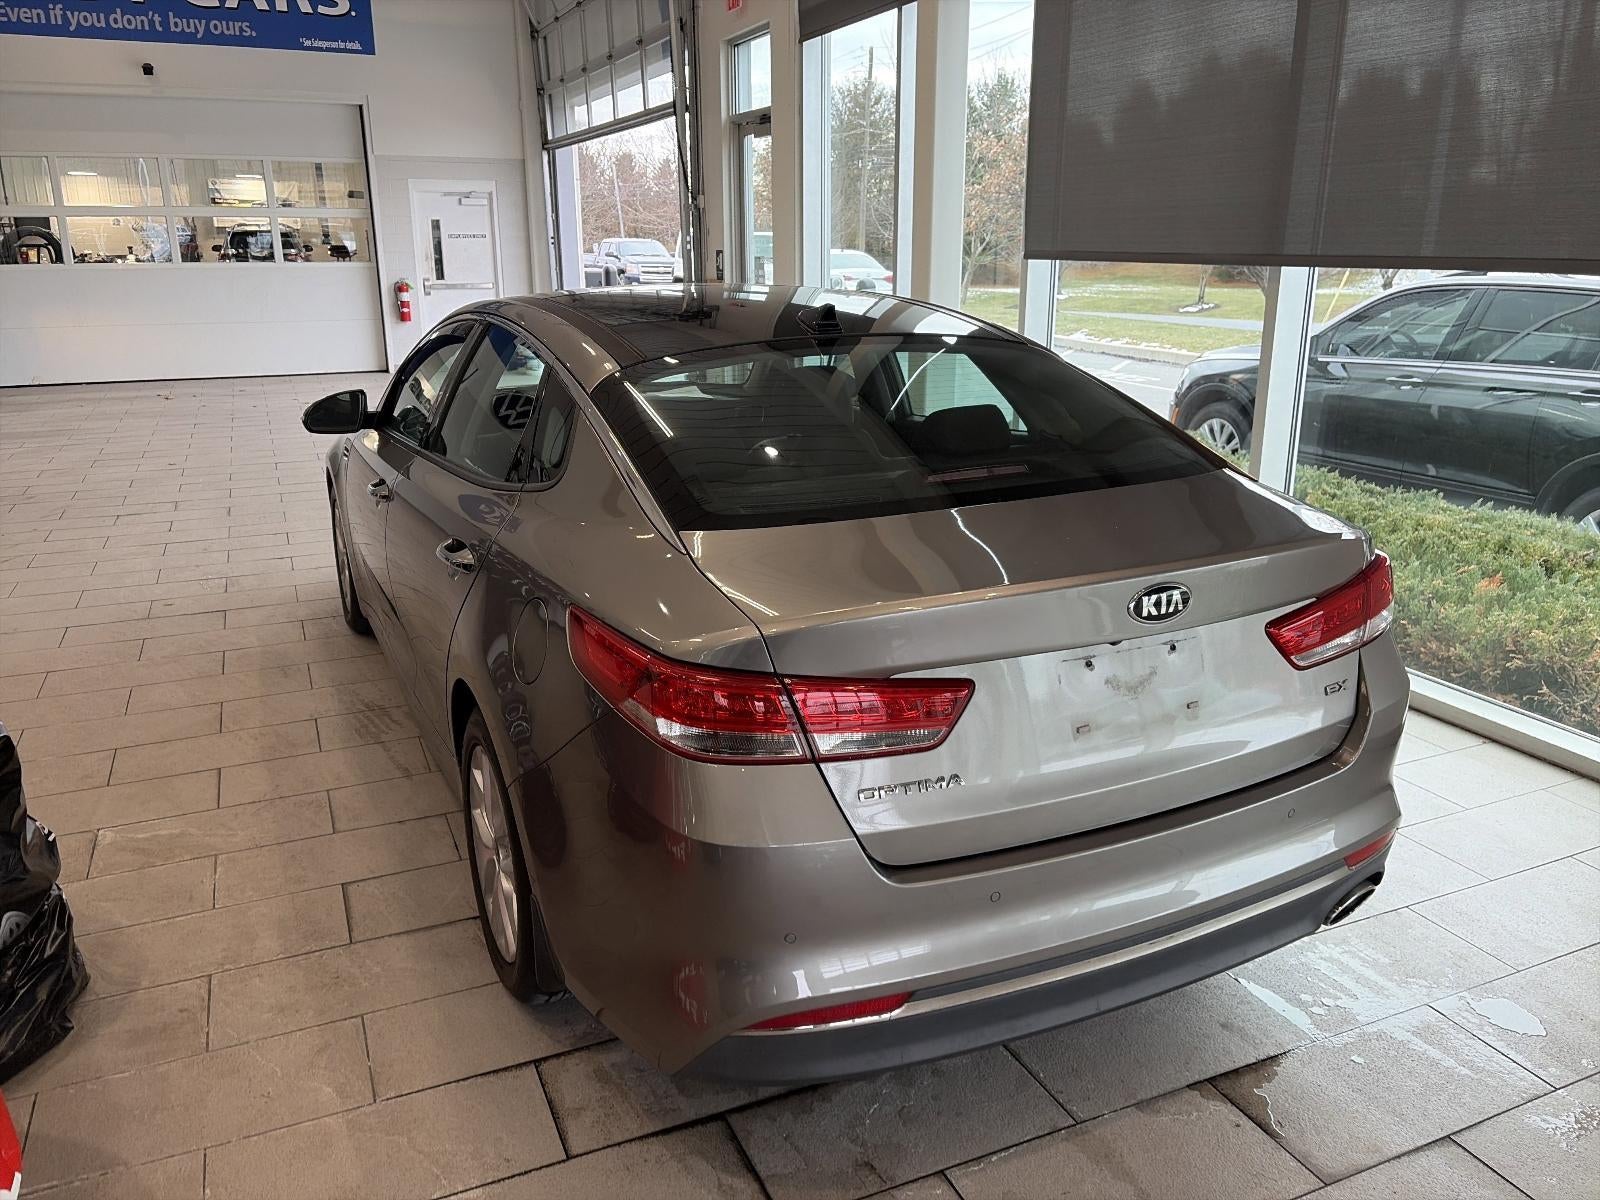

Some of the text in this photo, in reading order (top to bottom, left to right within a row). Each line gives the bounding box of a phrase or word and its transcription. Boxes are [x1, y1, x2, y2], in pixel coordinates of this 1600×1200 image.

[0, 2, 46, 24] Even
[50, 4, 63, 25] if
[66, 10, 106, 31] you
[109, 8, 163, 32] don't
[169, 11, 206, 38] buy
[209, 19, 257, 37] ours.
[312, 38, 338, 50] Salesperson
[346, 40, 362, 50] details.
[1142, 590, 1184, 618] KIA
[1324, 678, 1349, 697] EX
[858, 773, 966, 802] OPTIMA
